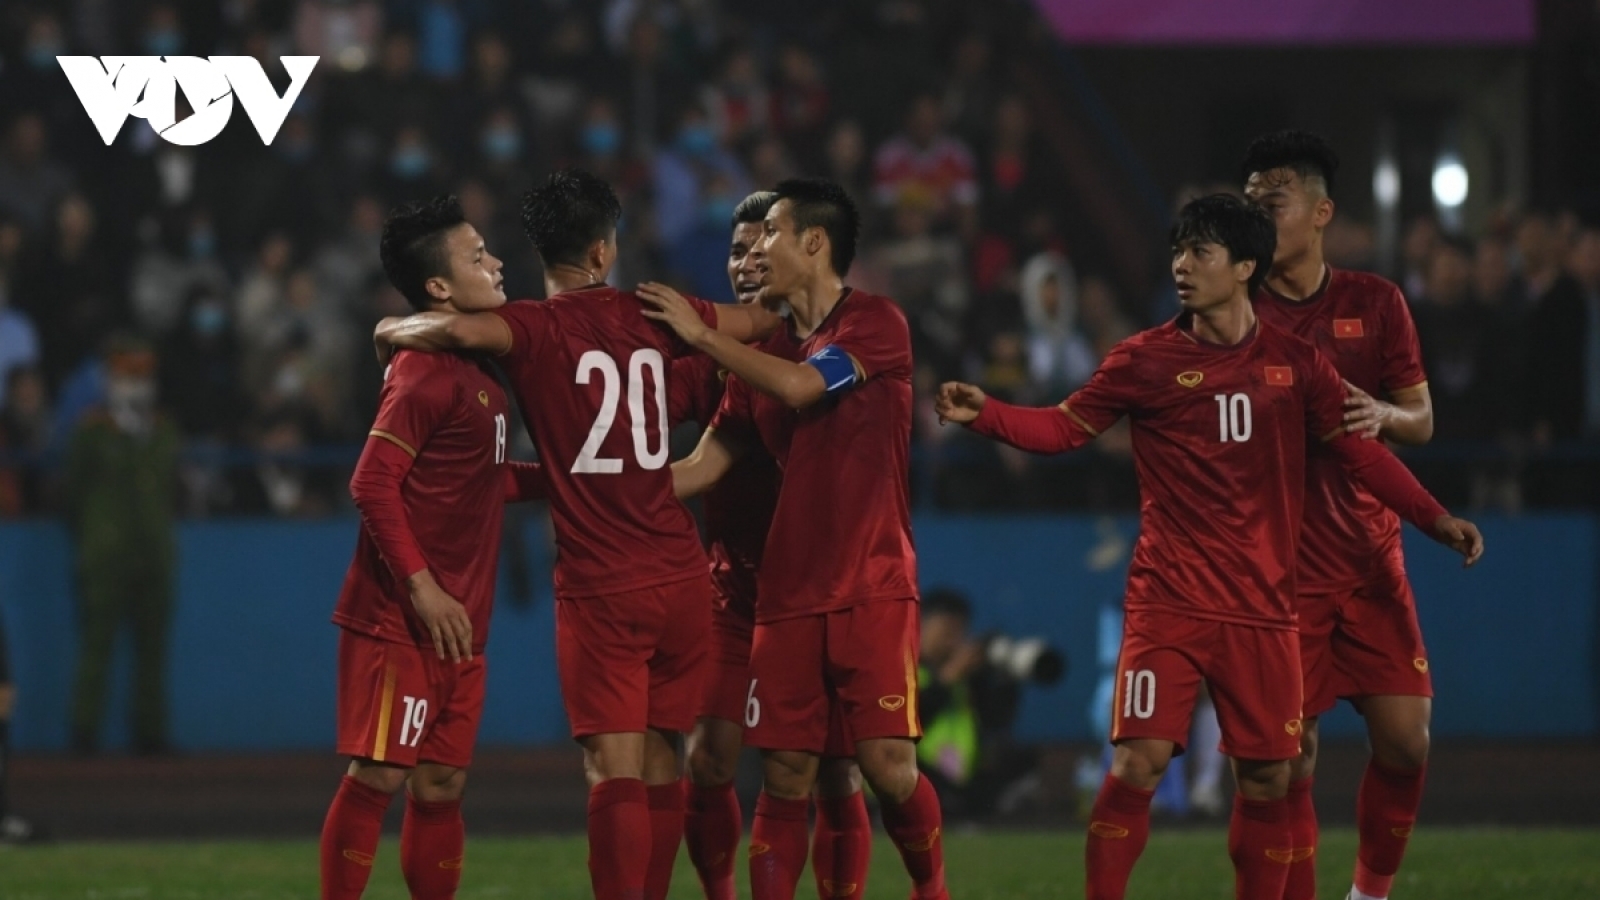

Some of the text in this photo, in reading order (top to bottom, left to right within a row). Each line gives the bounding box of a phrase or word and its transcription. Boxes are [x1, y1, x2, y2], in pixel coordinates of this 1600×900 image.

[570, 348, 669, 473] 20
[1215, 392, 1252, 442] 10
[494, 412, 506, 465] 19
[1124, 669, 1156, 719] 10
[399, 695, 428, 747] 19
